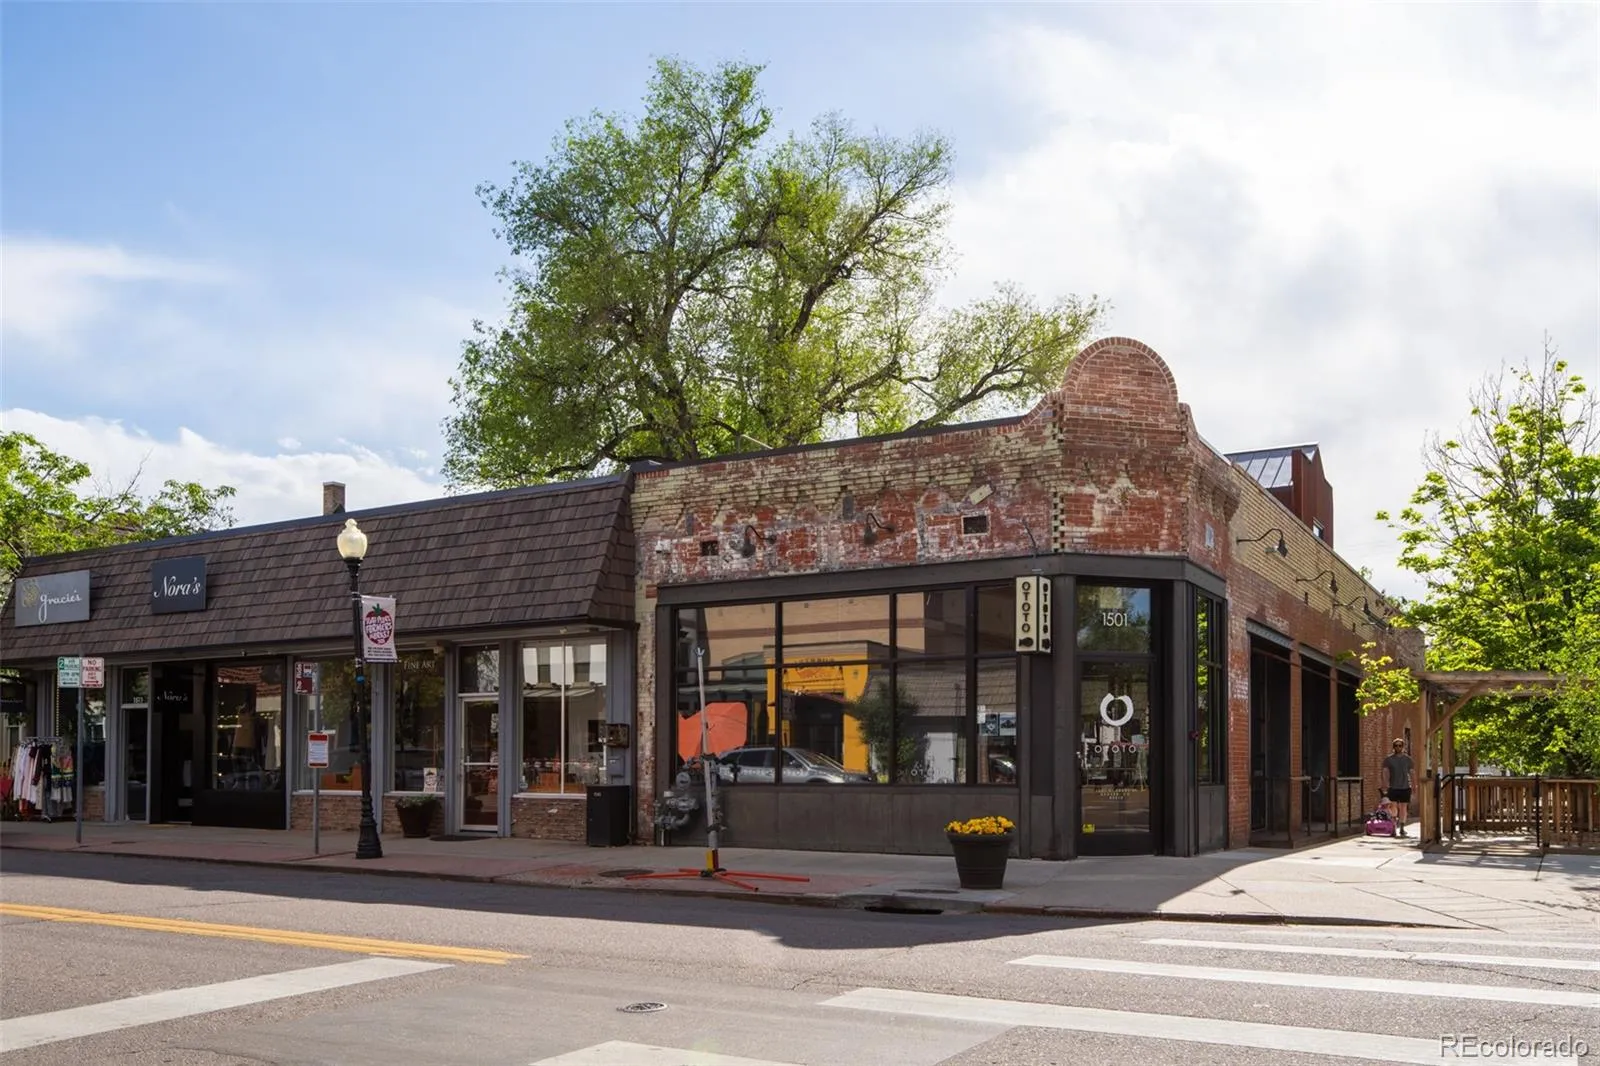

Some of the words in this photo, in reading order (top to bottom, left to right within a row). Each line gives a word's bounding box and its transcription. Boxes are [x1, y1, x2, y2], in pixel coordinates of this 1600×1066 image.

[153, 575, 201, 598] Nora's
[38, 589, 82, 623] gracie's
[1021, 581, 1031, 633] OTOTO
[1102, 612, 1129, 627] 1501
